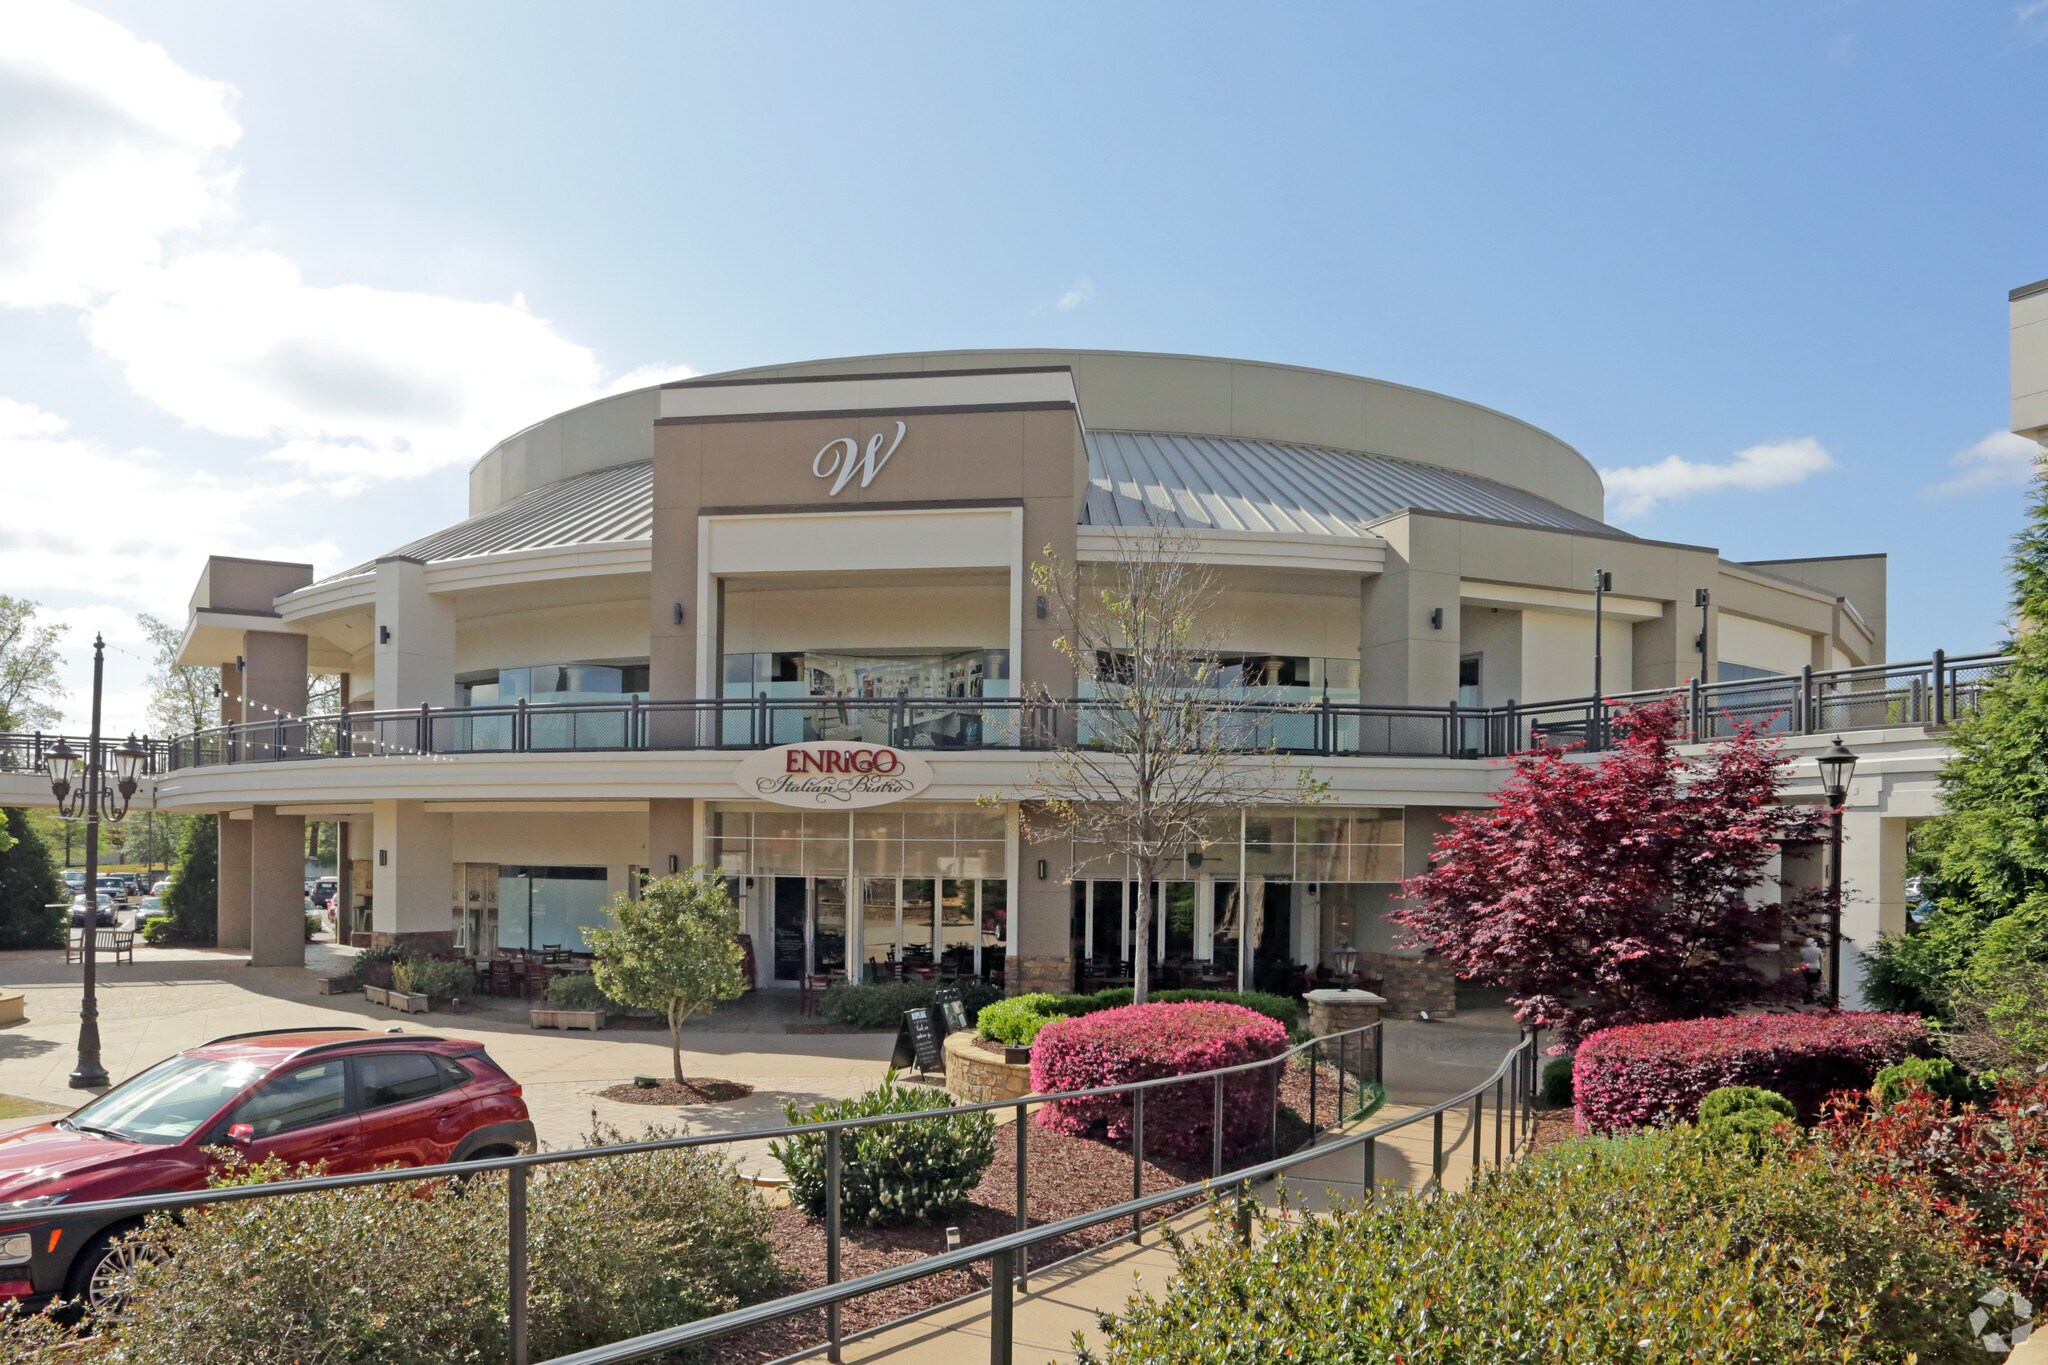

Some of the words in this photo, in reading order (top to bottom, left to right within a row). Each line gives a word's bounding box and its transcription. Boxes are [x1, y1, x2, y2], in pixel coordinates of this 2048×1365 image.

[812, 421, 907, 497] W
[757, 774, 837, 795] Italian
[838, 774, 915, 795] Bistro
